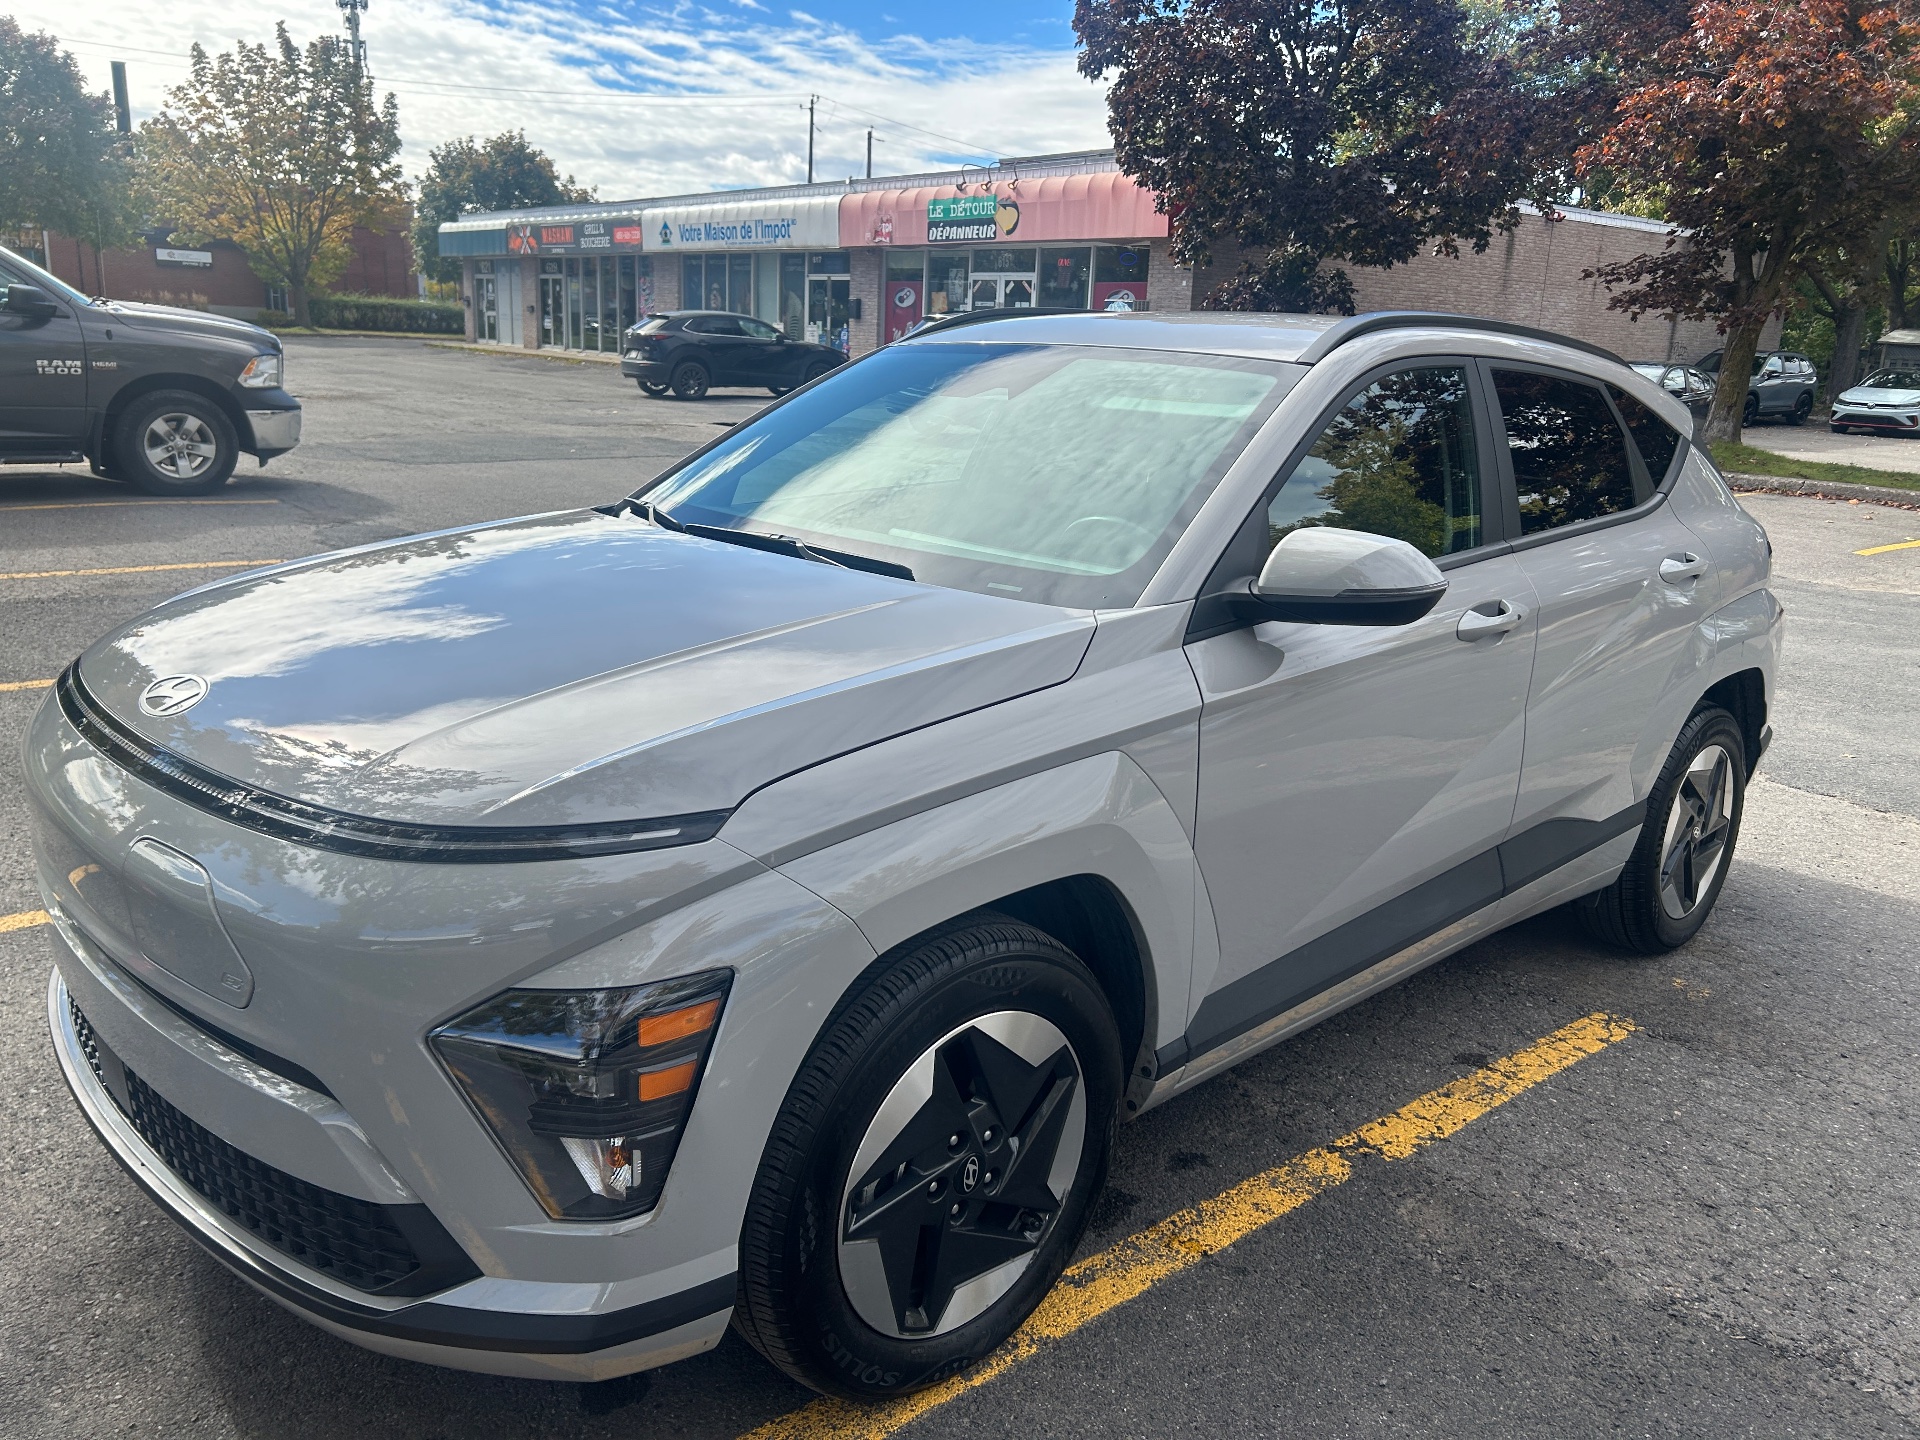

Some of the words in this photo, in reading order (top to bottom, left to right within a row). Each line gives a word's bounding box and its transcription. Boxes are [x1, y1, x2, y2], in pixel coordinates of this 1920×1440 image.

[928, 205, 944, 218] LE
[949, 200, 995, 217] DÉTOUR
[678, 223, 702, 242] Votre
[704, 222, 738, 241] Maison
[740, 220, 751, 239] de
[754, 217, 791, 243] l'Impôt
[928, 223, 996, 241] DÉPANNEUR
[36, 359, 82, 368] RAM
[36, 367, 82, 375] 1500
[820, 1332, 902, 1387] SOLUS
